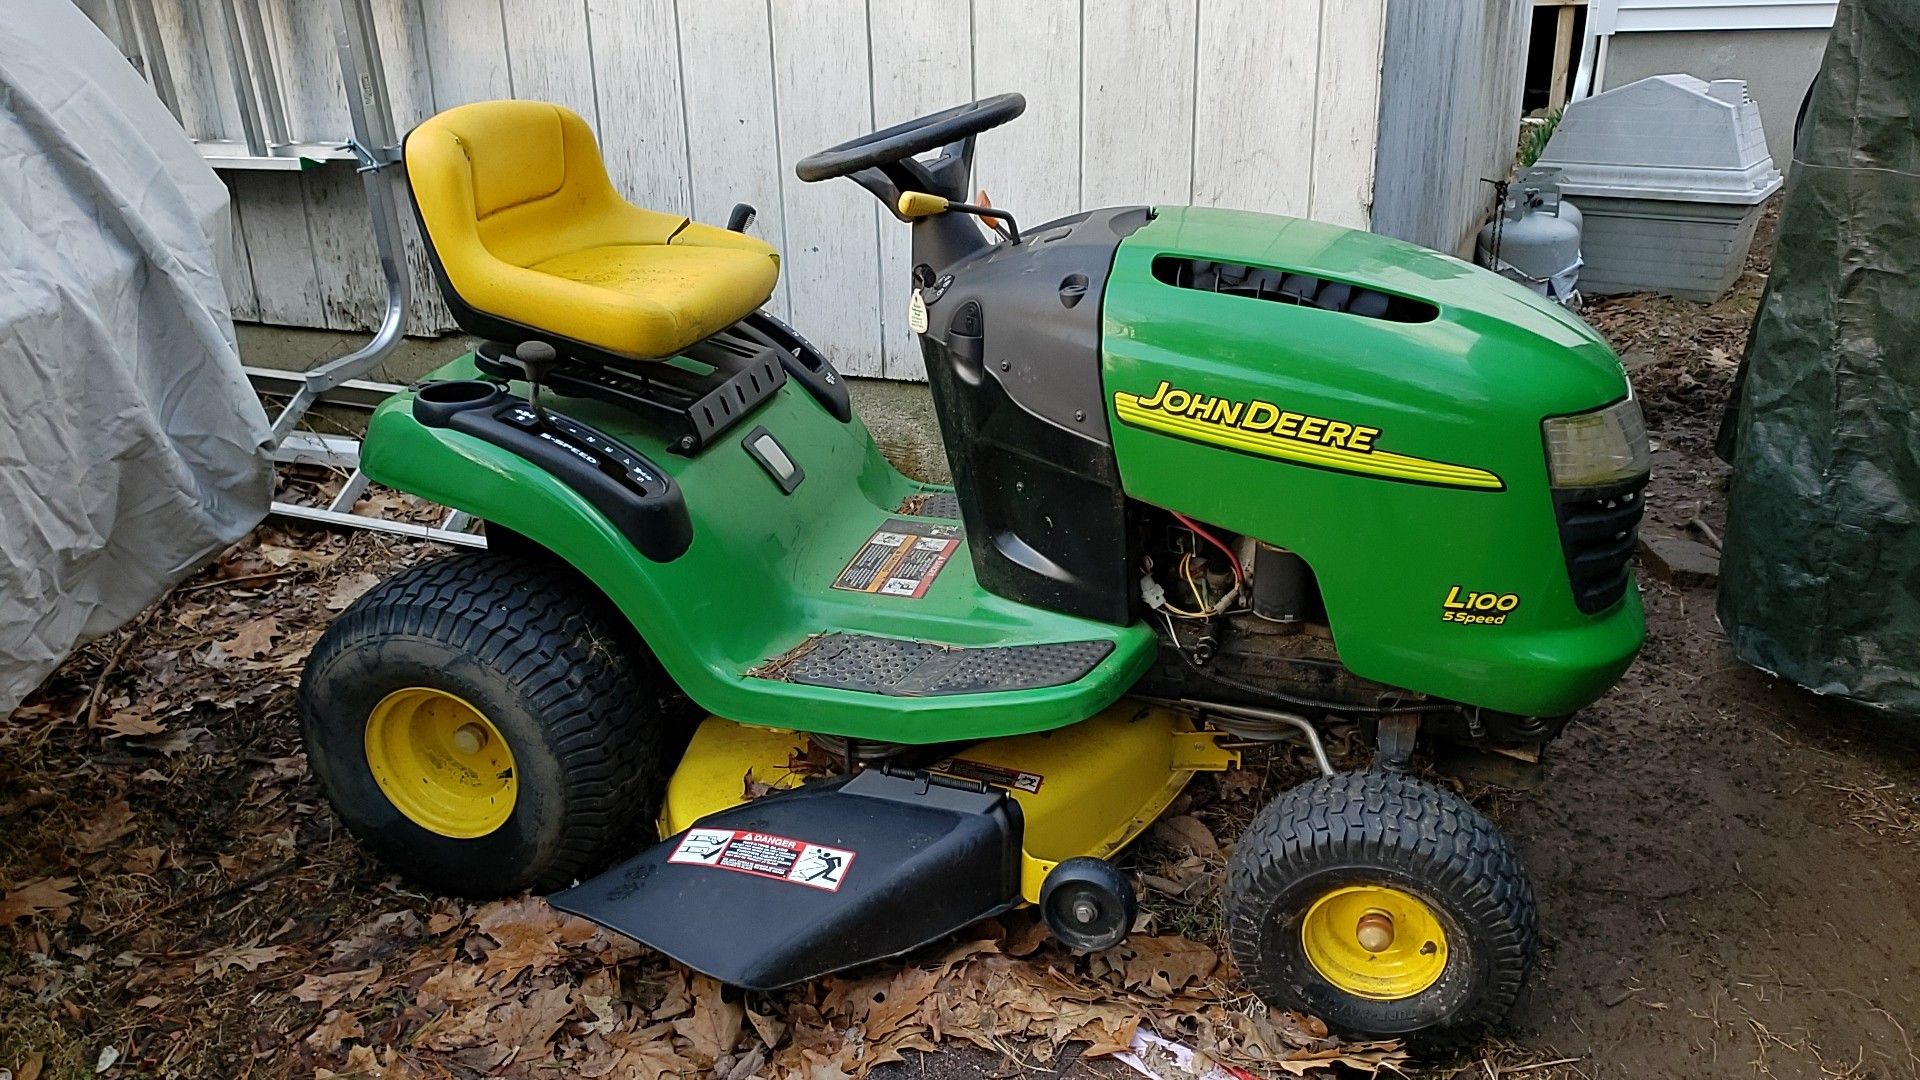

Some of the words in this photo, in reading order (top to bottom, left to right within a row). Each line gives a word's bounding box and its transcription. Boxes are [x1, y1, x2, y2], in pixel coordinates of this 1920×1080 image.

[1138, 382, 1243, 425] JOHN
[1243, 401, 1378, 450] DEERE
[540, 433, 597, 463] 5-SPEED
[1443, 586, 1518, 611] L100
[753, 834, 797, 849] DANGER
